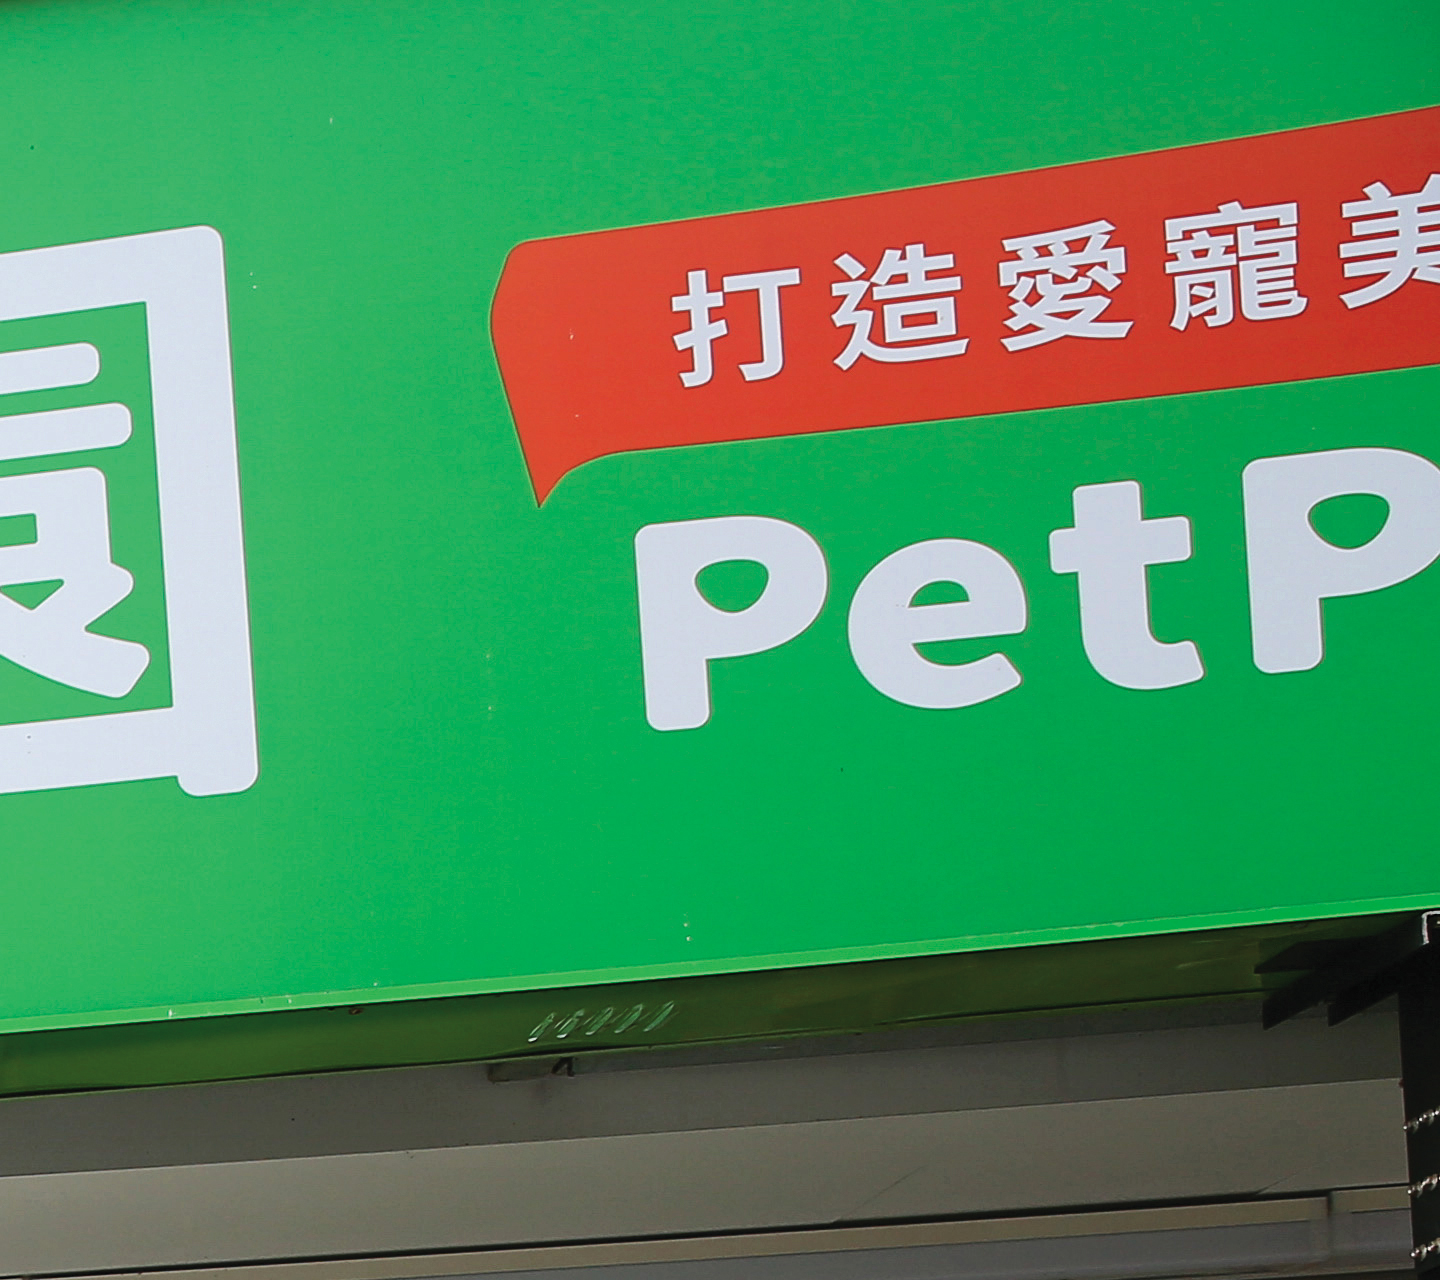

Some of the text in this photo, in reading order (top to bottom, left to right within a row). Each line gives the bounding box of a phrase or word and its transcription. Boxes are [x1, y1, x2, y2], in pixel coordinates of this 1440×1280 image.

[671, 173, 1440, 388] 打造愛寵美
[634, 446, 1440, 731] PetP
